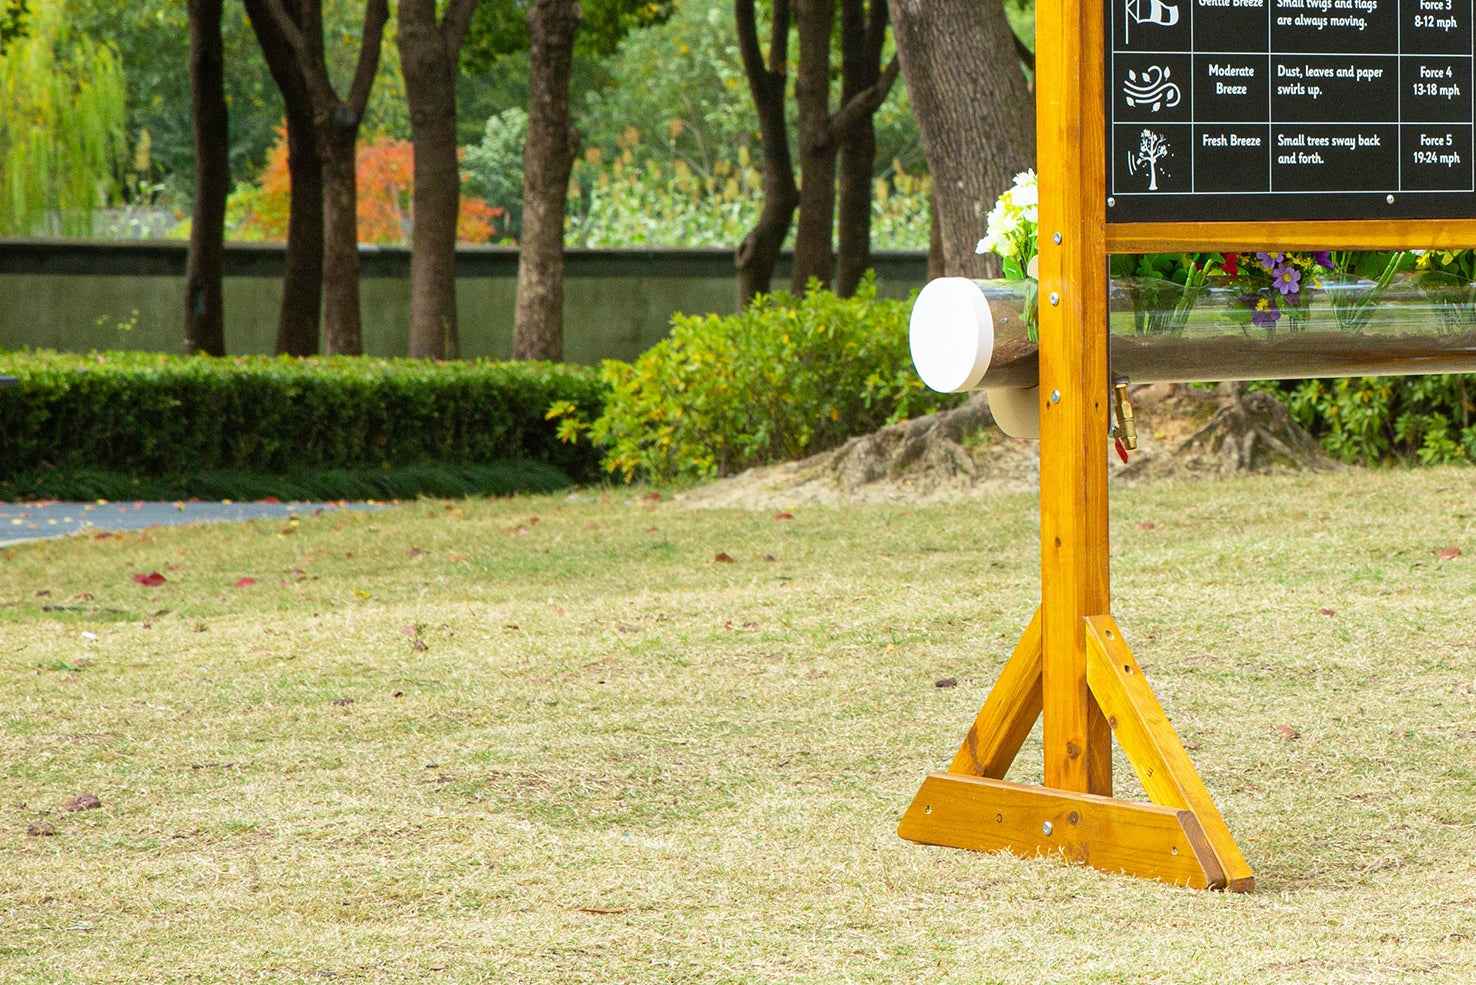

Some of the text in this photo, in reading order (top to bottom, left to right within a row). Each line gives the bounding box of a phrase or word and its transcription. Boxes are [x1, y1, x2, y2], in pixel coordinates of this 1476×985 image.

[1276, 13, 1368, 31] are always moving.
[1414, 14, 1458, 32] 8-12 mph
[1208, 63, 1255, 77] Moderate
[1277, 64, 1384, 82] Dust, leaves and paper
[1420, 65, 1453, 79] Force 4
[1216, 81, 1248, 95] Breeze
[1277, 82, 1323, 100] swirls up.
[1412, 82, 1461, 100] 13-18 mph
[1202, 133, 1262, 147] Fresh Breeze
[1277, 133, 1381, 151] Small trees sway back
[1420, 133, 1453, 146] Force 5
[1277, 151, 1325, 165] and forth.
[1413, 151, 1461, 168] 19-24 mph
